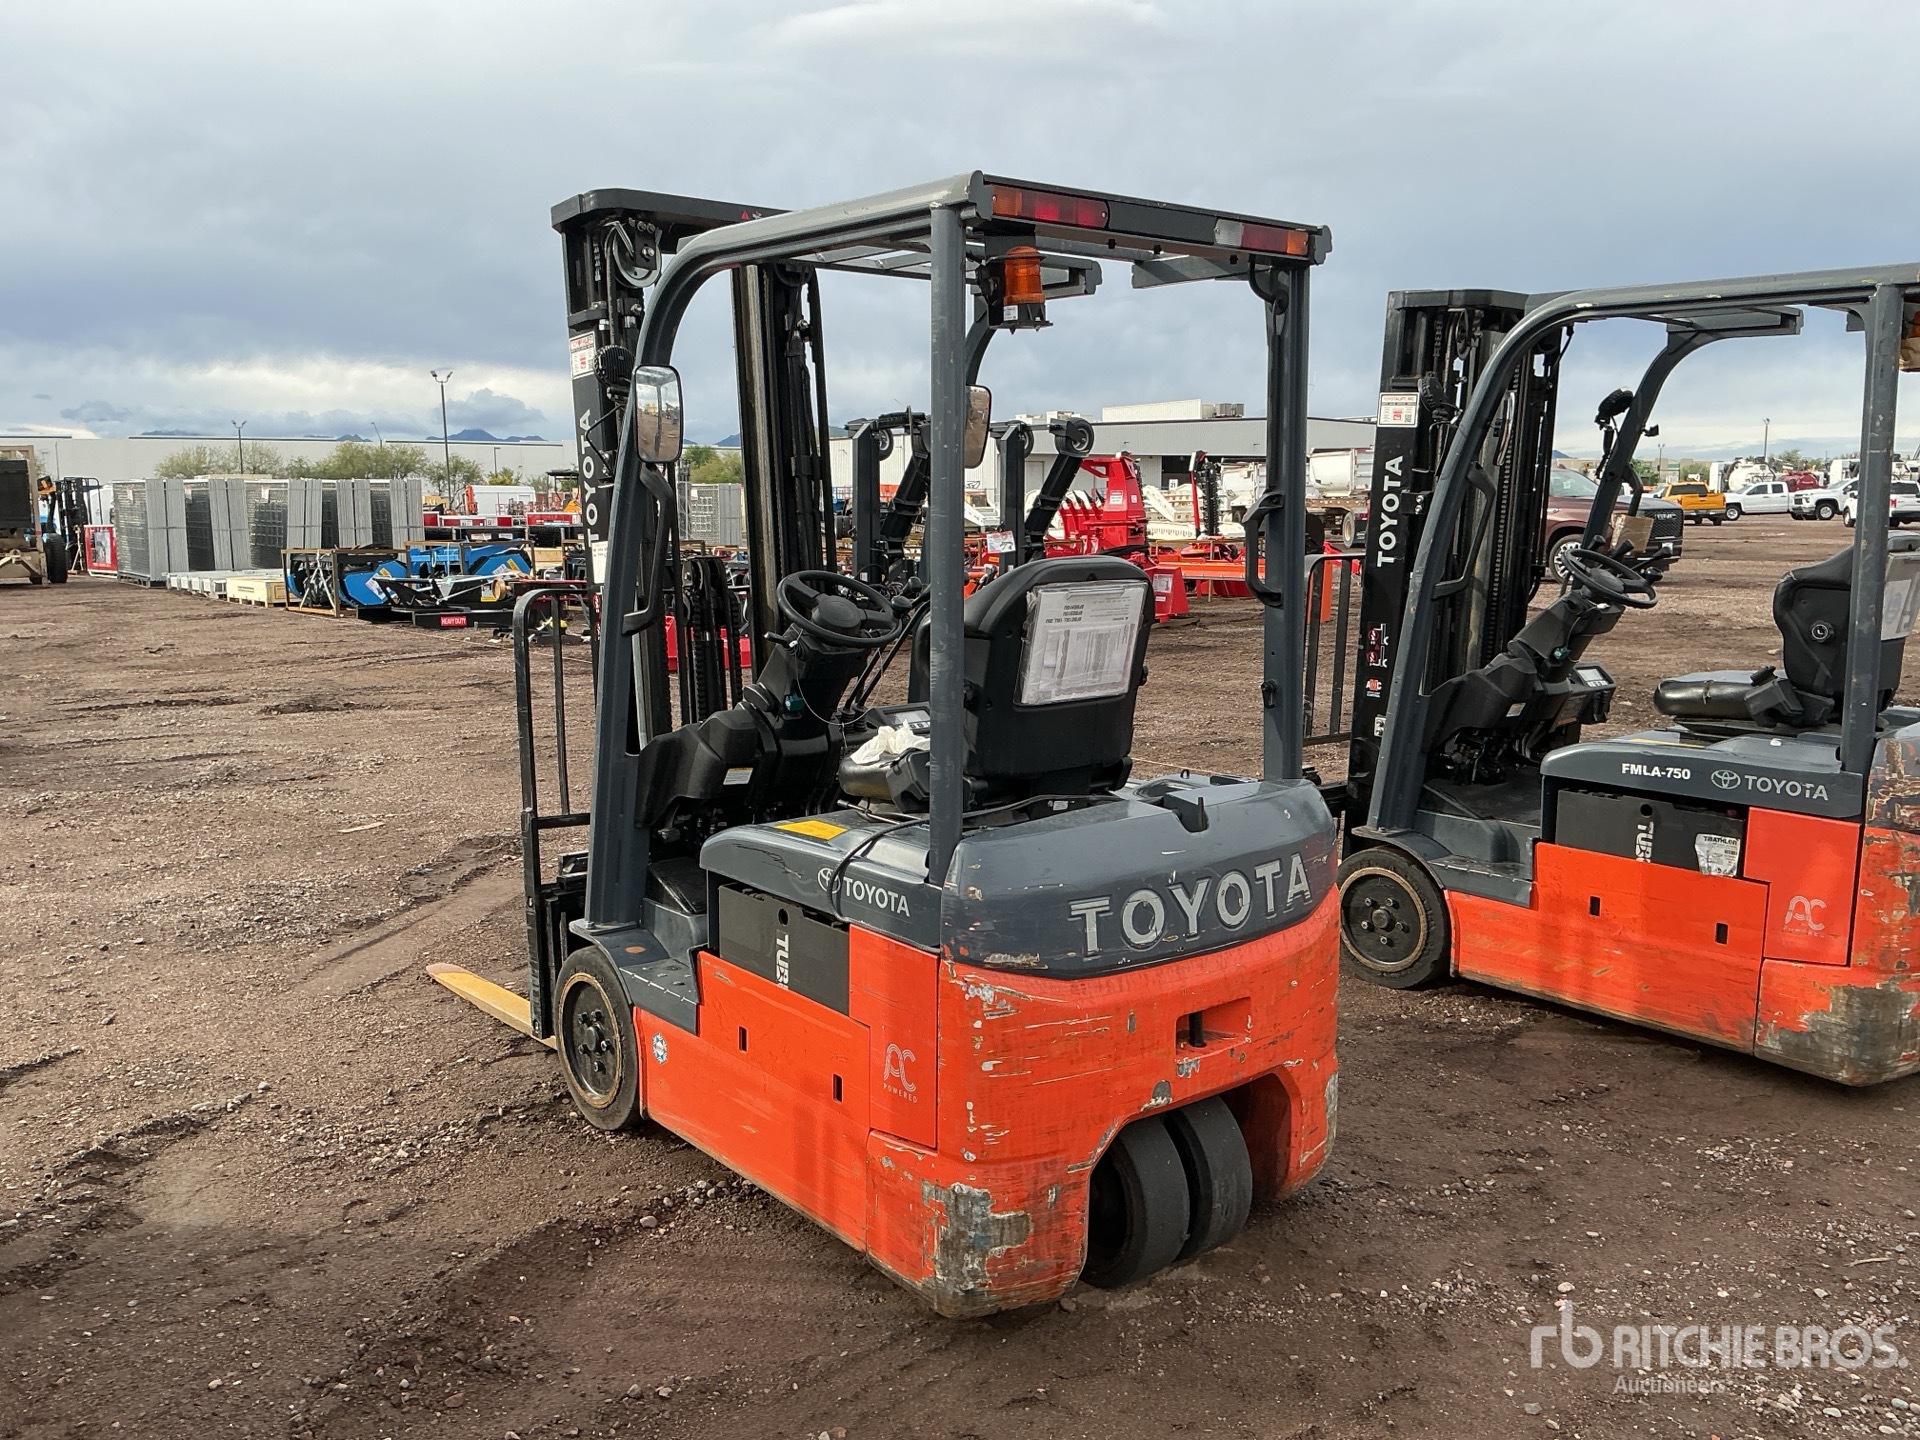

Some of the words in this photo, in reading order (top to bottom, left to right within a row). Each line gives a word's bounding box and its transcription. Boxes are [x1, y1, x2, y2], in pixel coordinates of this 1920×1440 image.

[579, 408, 601, 548] TOYOTA
[1377, 456, 1403, 567] TOYOTA
[454, 616, 466, 625] DUTY
[1621, 763, 1691, 780] FMLA-750
[1744, 774, 1829, 801] TOYOTA
[843, 876, 910, 918] TOYOTA
[1070, 853, 1312, 956] TOYOTA
[883, 1083, 918, 1104] POWERED
